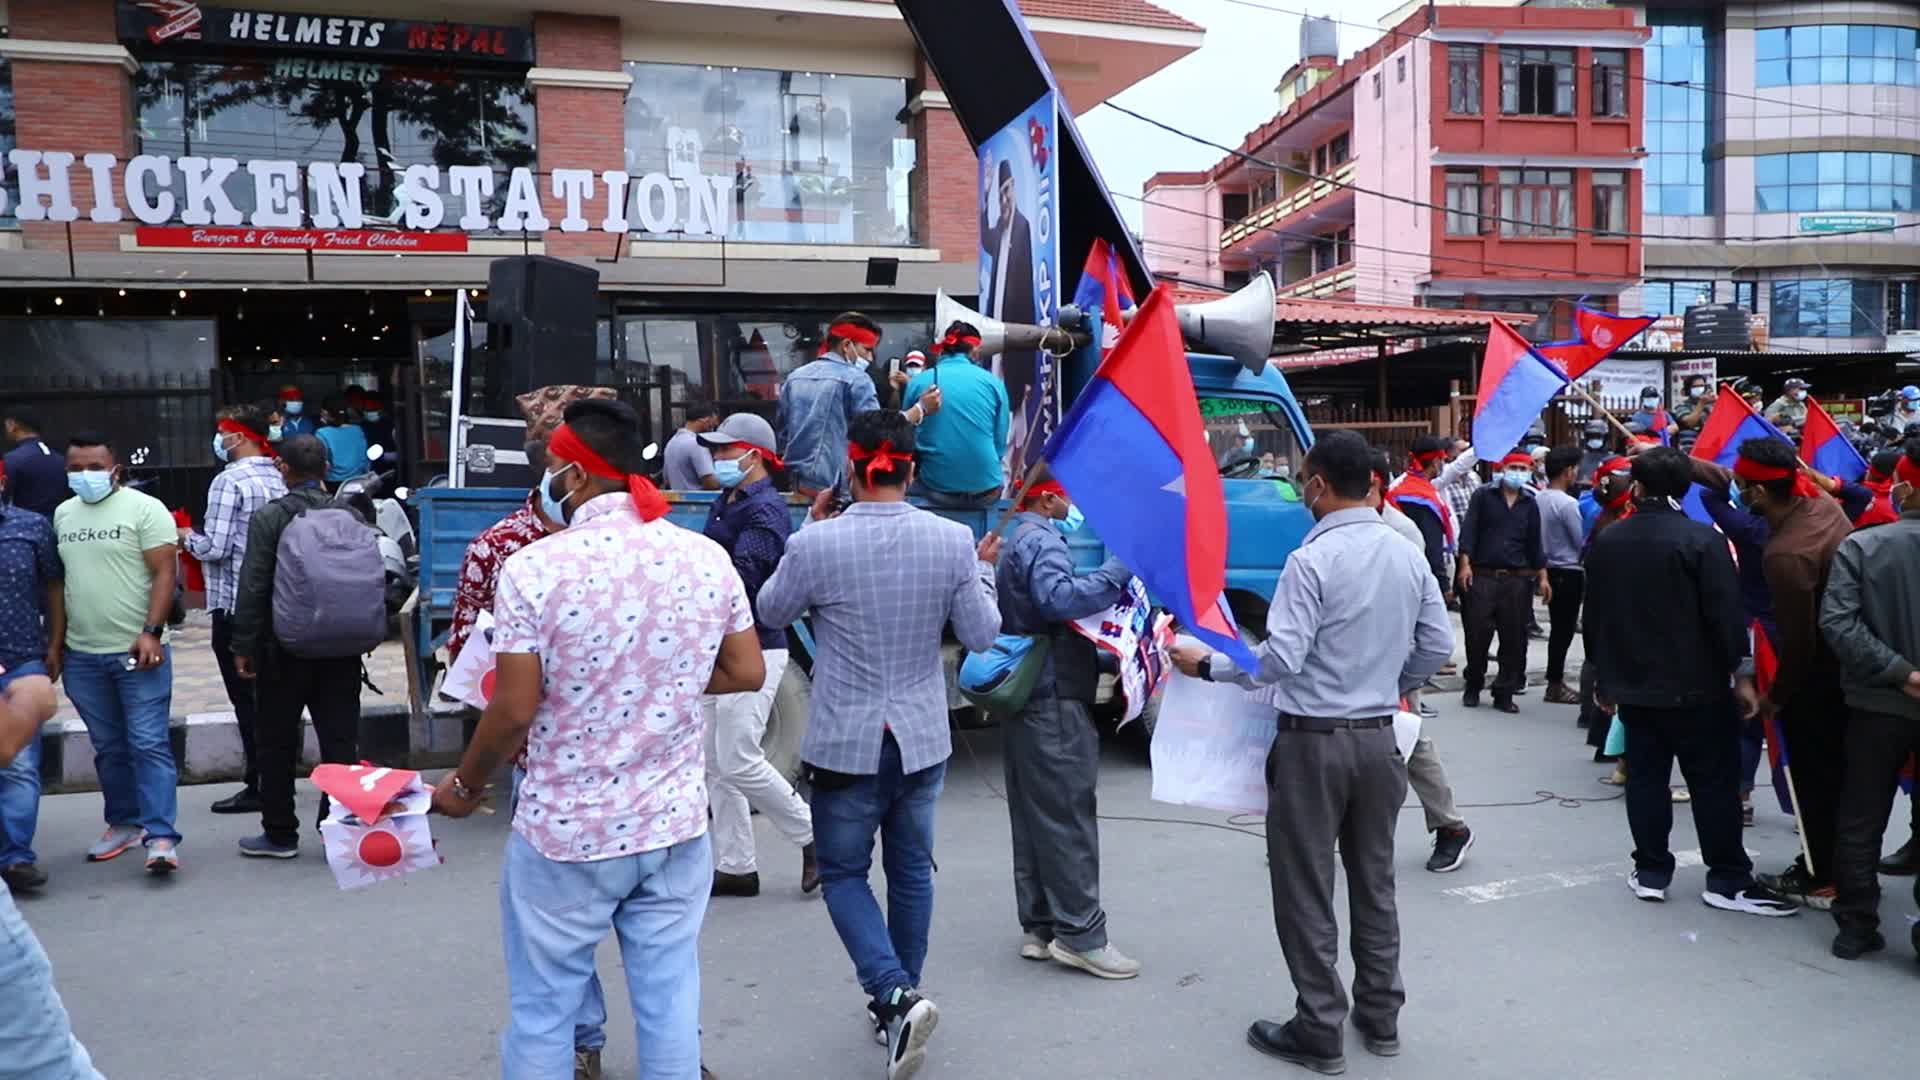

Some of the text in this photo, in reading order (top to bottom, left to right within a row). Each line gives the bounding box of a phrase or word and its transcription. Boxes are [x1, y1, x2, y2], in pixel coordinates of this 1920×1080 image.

[229, 11, 386, 47] HELMETS
[407, 24, 507, 55] NEPAL
[0, 149, 734, 236] HICKEN STATION
[191, 228, 418, 248] Burger & Crunchy Fried Chicken
[1039, 261, 1052, 326] KP
